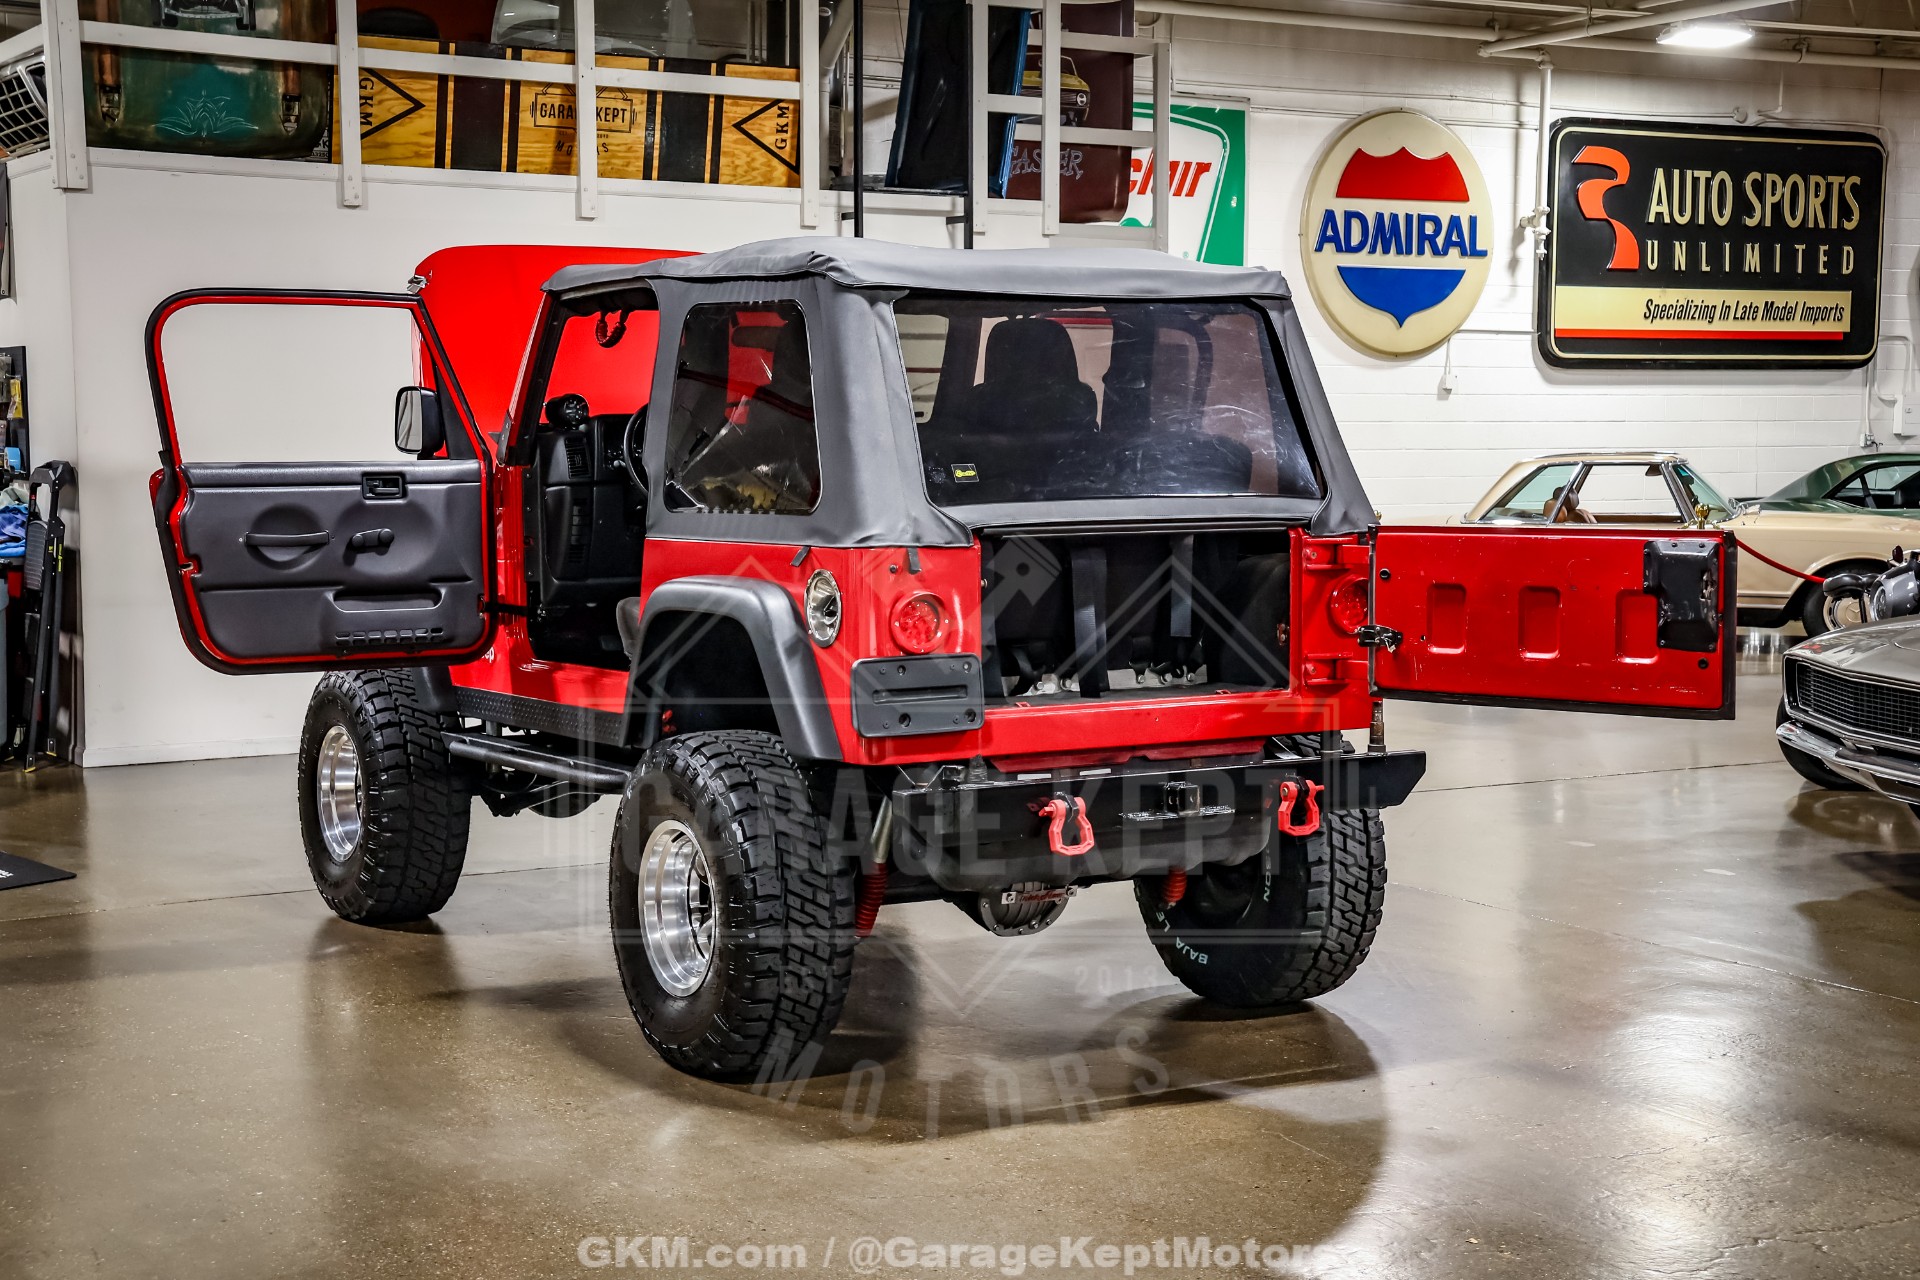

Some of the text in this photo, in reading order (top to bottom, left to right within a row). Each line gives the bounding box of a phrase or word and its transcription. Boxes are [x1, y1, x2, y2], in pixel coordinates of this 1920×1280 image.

[358, 78, 374, 126] GKM
[540, 102, 628, 123] GARA KEPT
[775, 105, 790, 150] GKM
[1646, 167, 1861, 231] AUTO SPORTS
[1314, 209, 1488, 257] ADMIRAL
[1646, 239, 1854, 275] UNLIMITED
[1643, 298, 1845, 325] Specializing In Late Model Imports
[1175, 937, 1209, 965] BAJA
